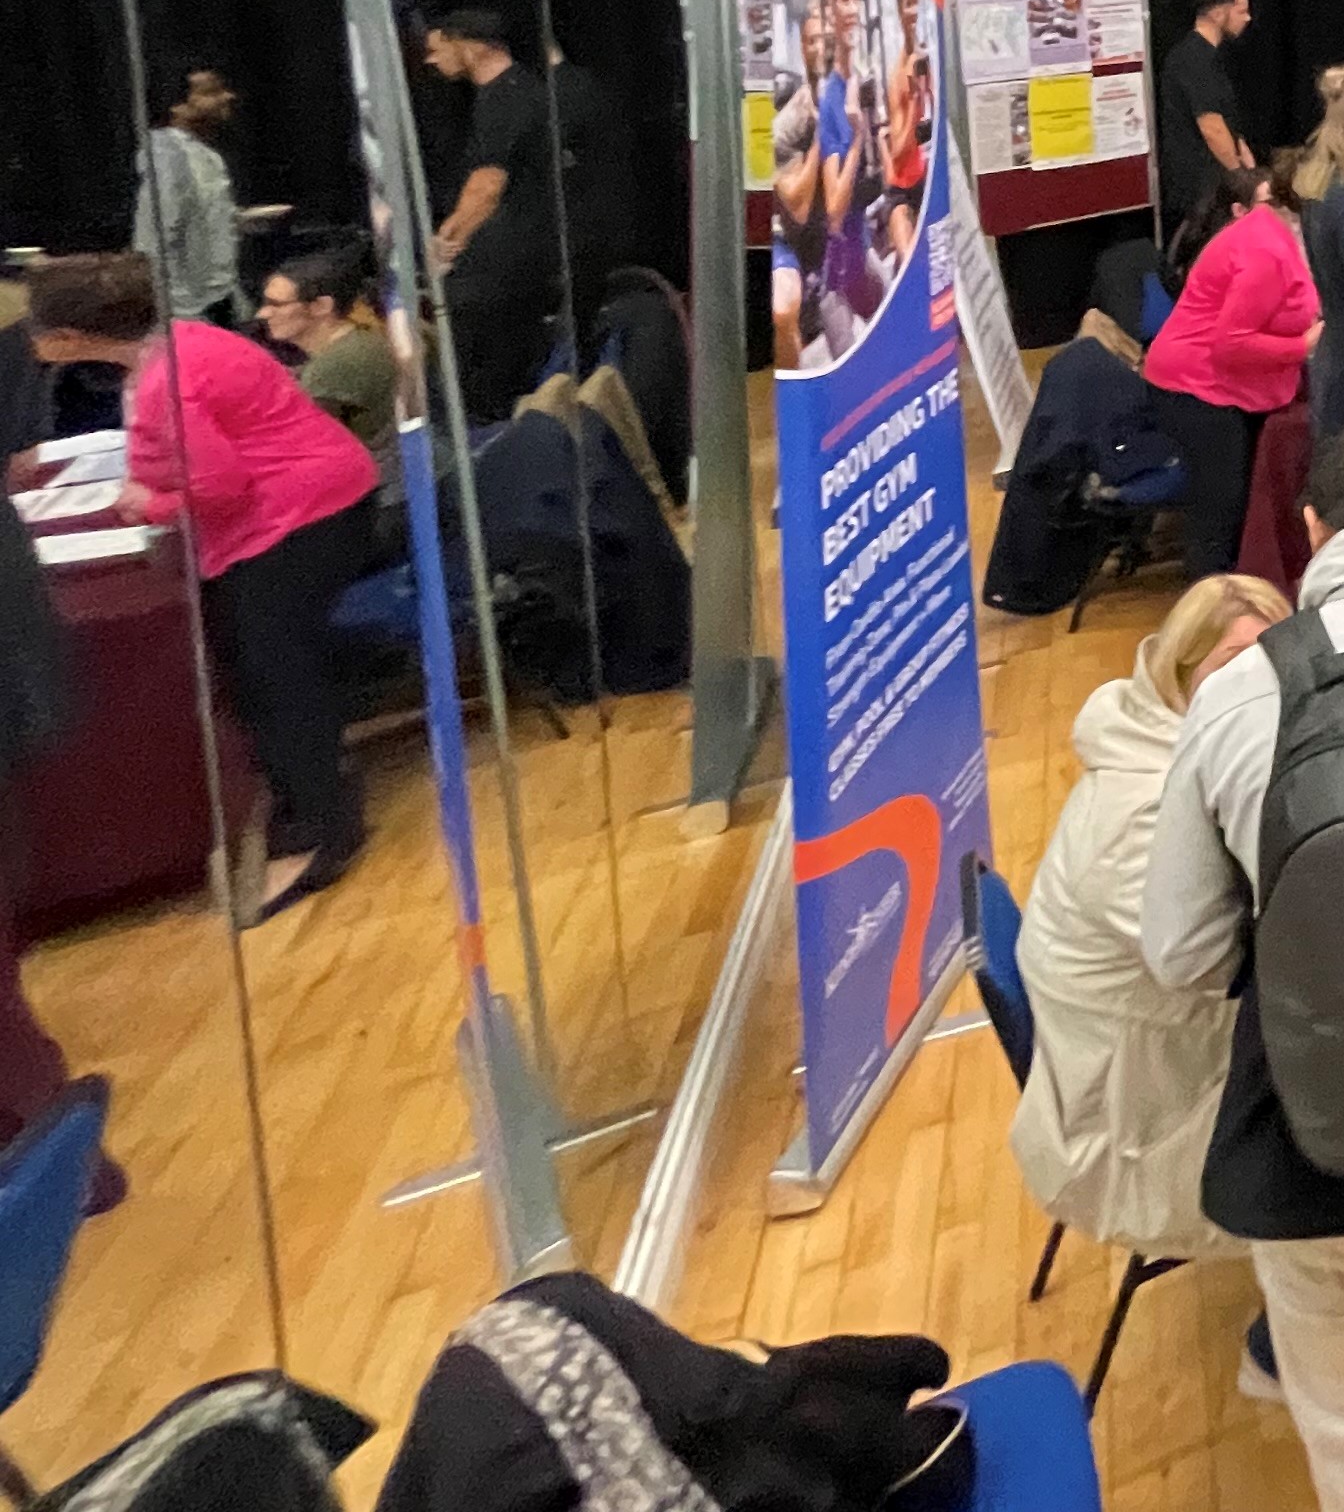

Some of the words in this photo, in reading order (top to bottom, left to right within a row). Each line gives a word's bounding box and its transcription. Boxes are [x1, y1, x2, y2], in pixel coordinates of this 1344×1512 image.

[821, 397, 926, 510] PROVIDING
[926, 367, 960, 417] THE
[822, 486, 874, 566] BEST
[873, 452, 919, 513] GYM
[824, 486, 937, 623] EQUIPMENT
